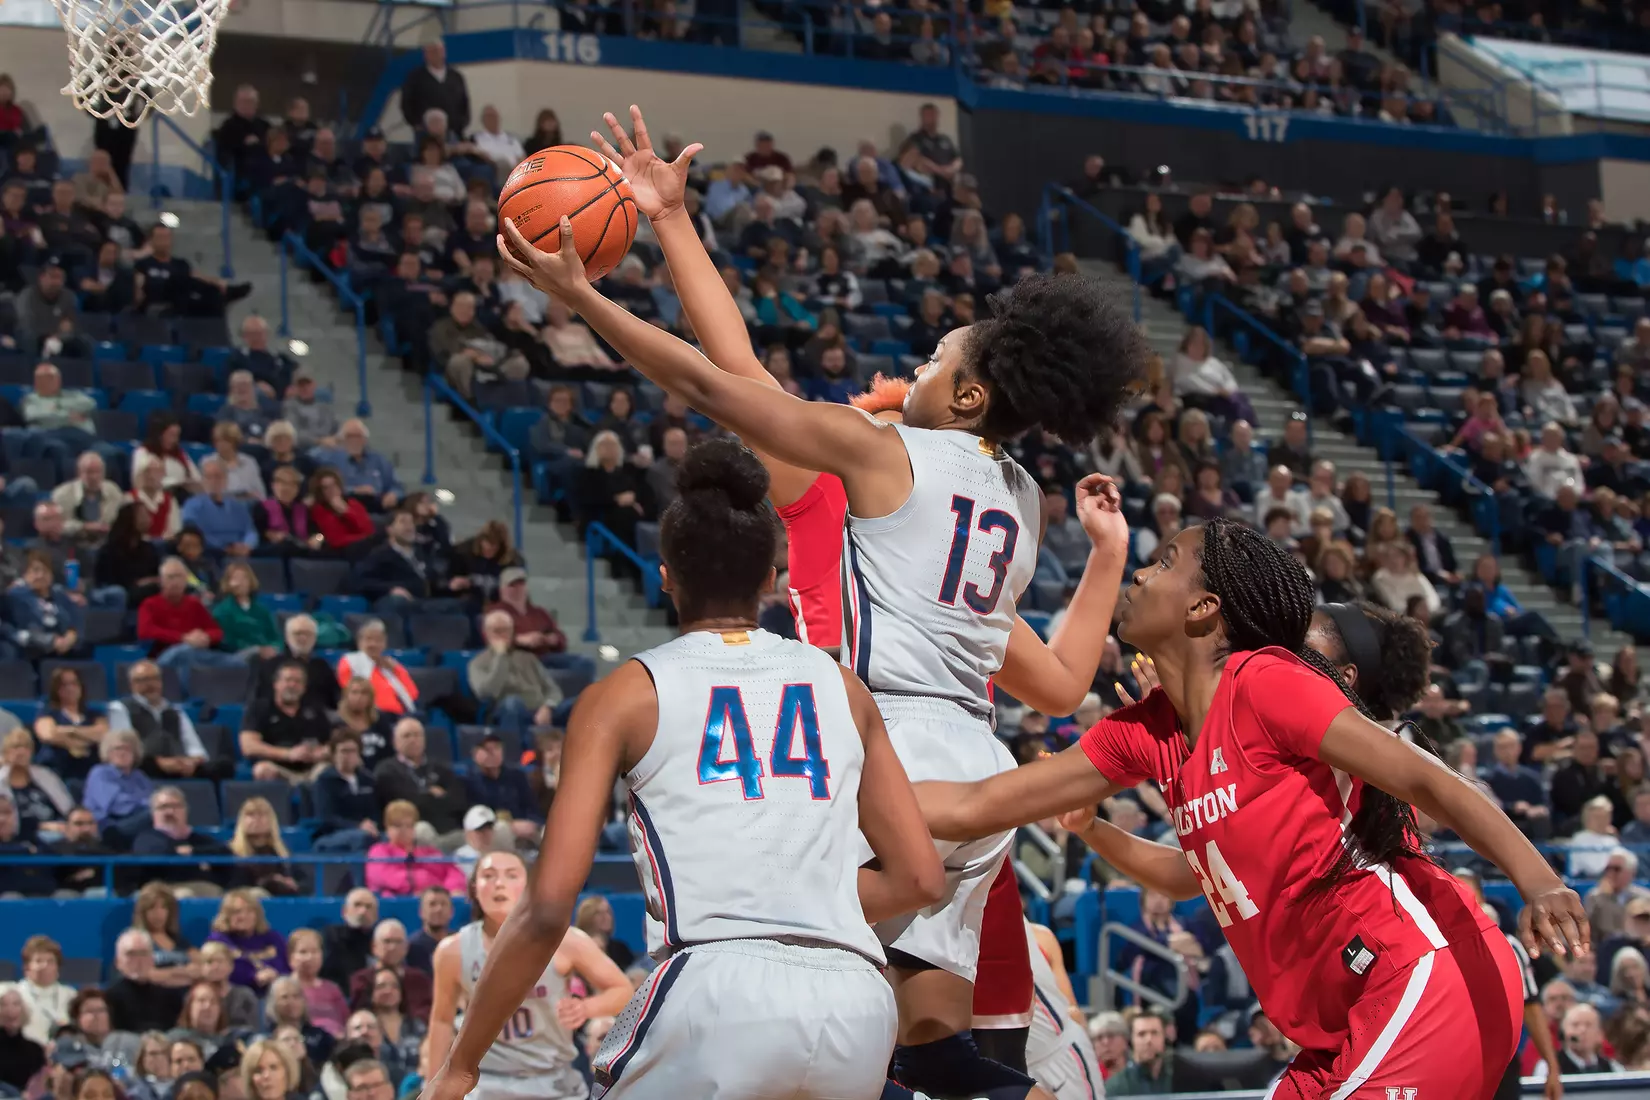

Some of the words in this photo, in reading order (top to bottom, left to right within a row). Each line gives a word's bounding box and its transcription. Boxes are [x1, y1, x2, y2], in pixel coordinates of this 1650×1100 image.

[541, 33, 601, 63] 116
[1243, 116, 1289, 142] 117
[938, 493, 1020, 616] 13
[696, 683, 831, 801] 44
[1210, 746, 1228, 775] A
[1173, 782, 1239, 837] STON
[1185, 839, 1260, 928] 24
